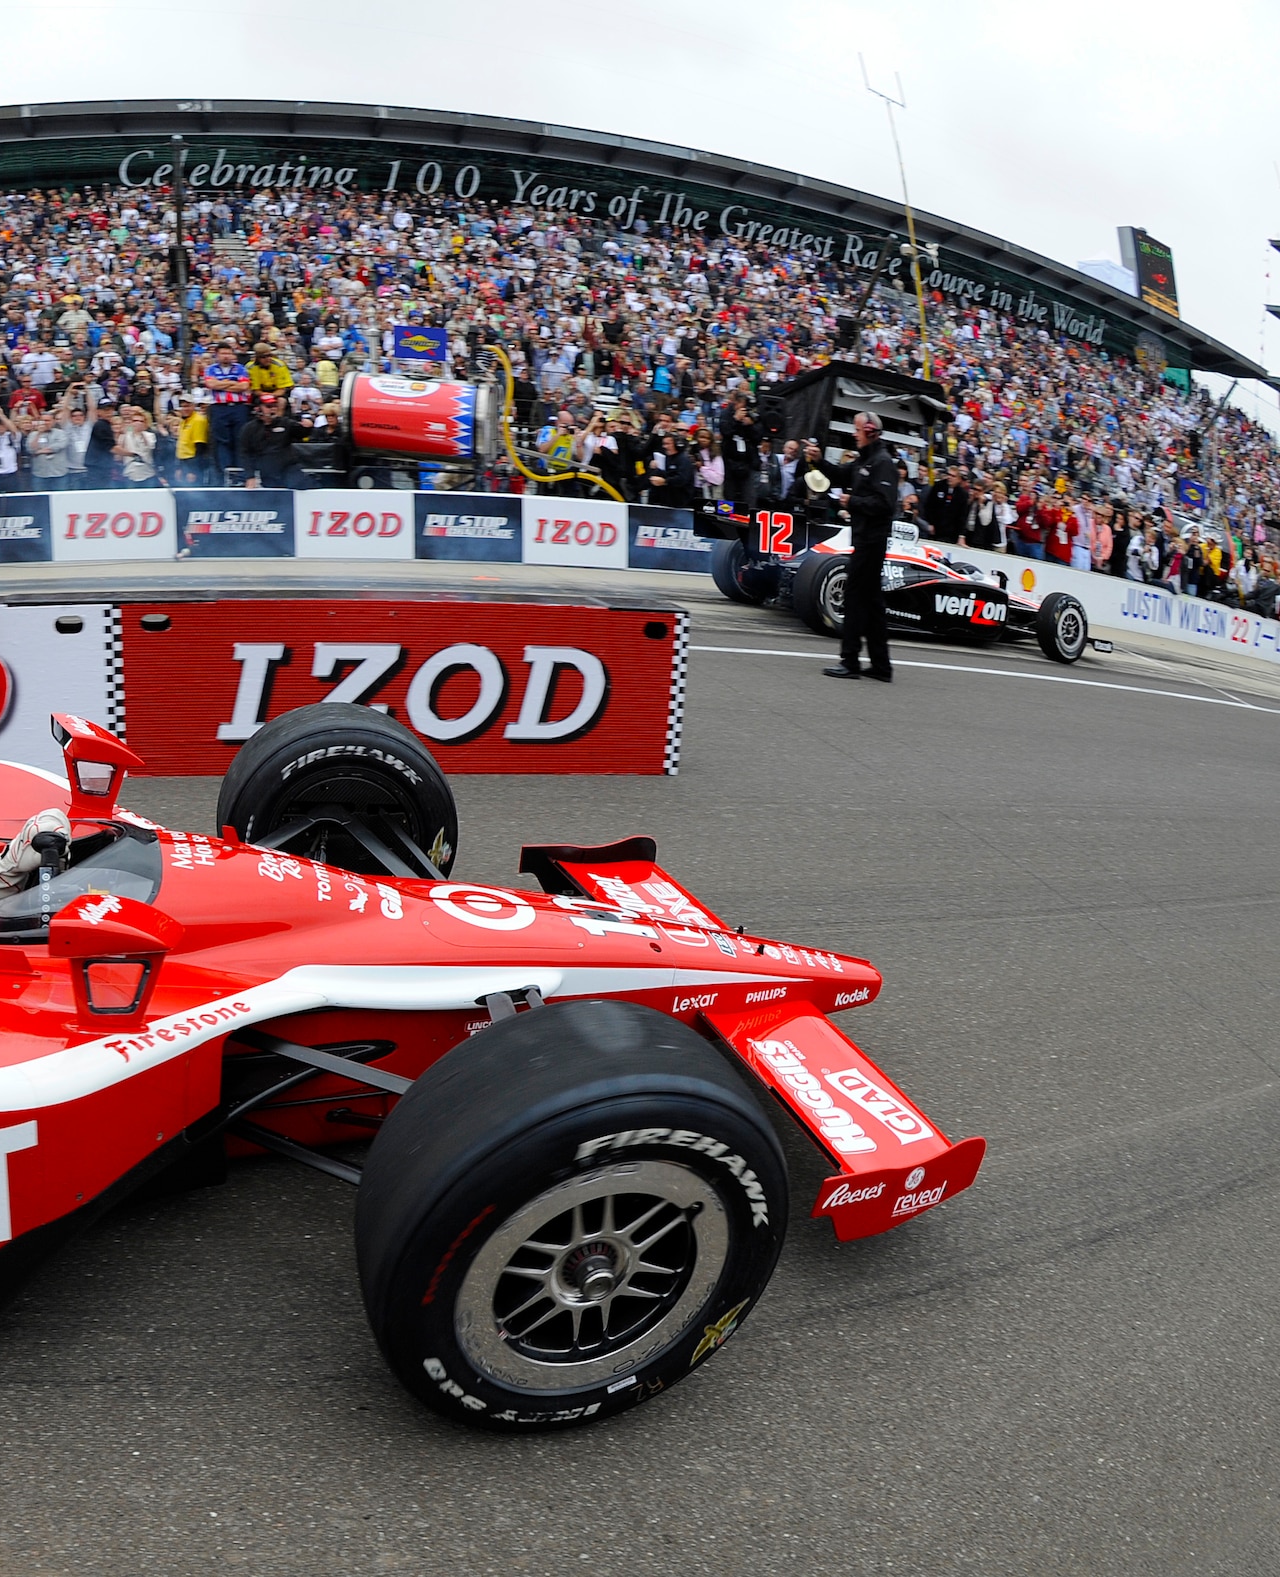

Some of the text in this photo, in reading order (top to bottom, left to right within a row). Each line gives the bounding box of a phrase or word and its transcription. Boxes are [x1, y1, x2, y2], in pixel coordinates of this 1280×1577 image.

[119, 149, 357, 195] Celebrating
[512, 169, 596, 213] Years
[608, 185, 647, 230] of
[654, 192, 710, 230] The
[720, 205, 835, 257] Greatest
[990, 281, 1013, 311] in
[1018, 291, 1048, 323] the
[1052, 301, 1105, 345] World
[65, 511, 164, 539] IZOD
[188, 511, 278, 523] PIT STOP
[308, 511, 403, 537] IZOD
[425, 514, 509, 528] PIT STOP
[534, 518, 618, 546] IZOD
[756, 510, 794, 556] 12
[935, 593, 1007, 626] verizon
[1121, 588, 1173, 625] JUSTIN
[1178, 600, 1228, 639] WILSON
[1230, 615, 1249, 644] 22
[217, 641, 609, 743] IZOD
[281, 745, 423, 785] FIREHAWK
[672, 992, 718, 1013] Lexar
[745, 987, 787, 1004] PHILIPS
[835, 987, 870, 1006] Kodak
[104, 1001, 251, 1063] Firestone
[838, 1075, 922, 1135] GLAD
[575, 1127, 769, 1228] FIREHAWK
[822, 1182, 886, 1209] Reese's
[893, 1180, 947, 1212] reveal
